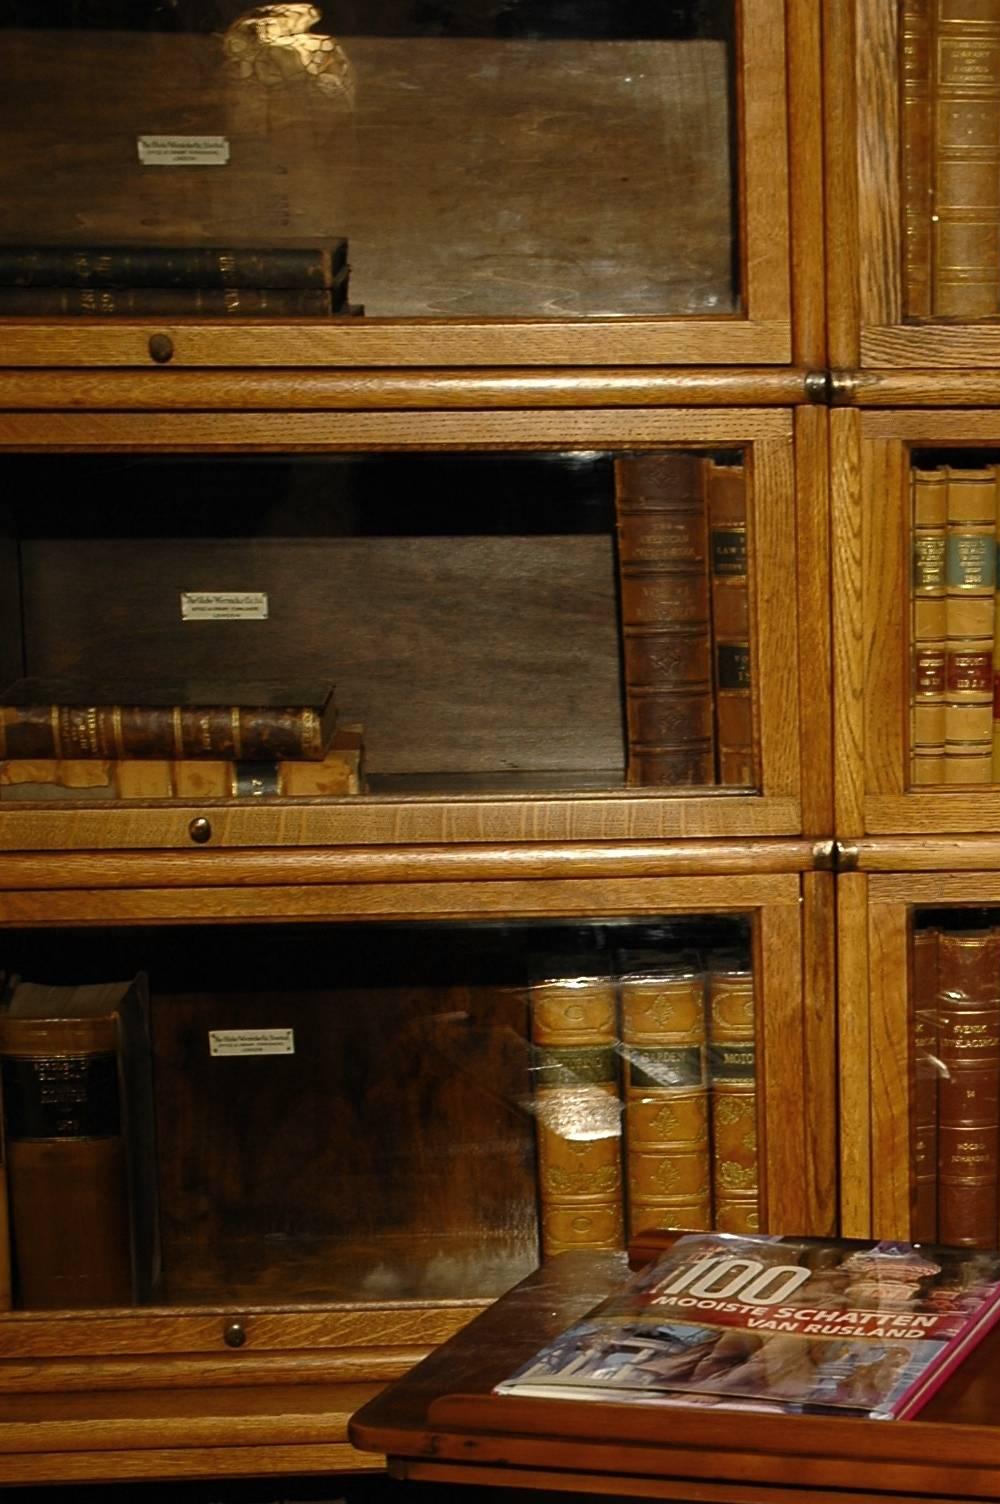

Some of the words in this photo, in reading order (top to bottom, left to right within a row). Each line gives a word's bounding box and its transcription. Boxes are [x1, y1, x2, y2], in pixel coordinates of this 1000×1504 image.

[723, 1053, 754, 1064] MOTO
[665, 1256, 812, 1305] 100
[651, 1295, 768, 1317] MOOISTE
[772, 1306, 940, 1328] SCHATTEN
[746, 1317, 799, 1333] VAN
[803, 1322, 926, 1339] RUSLAND
